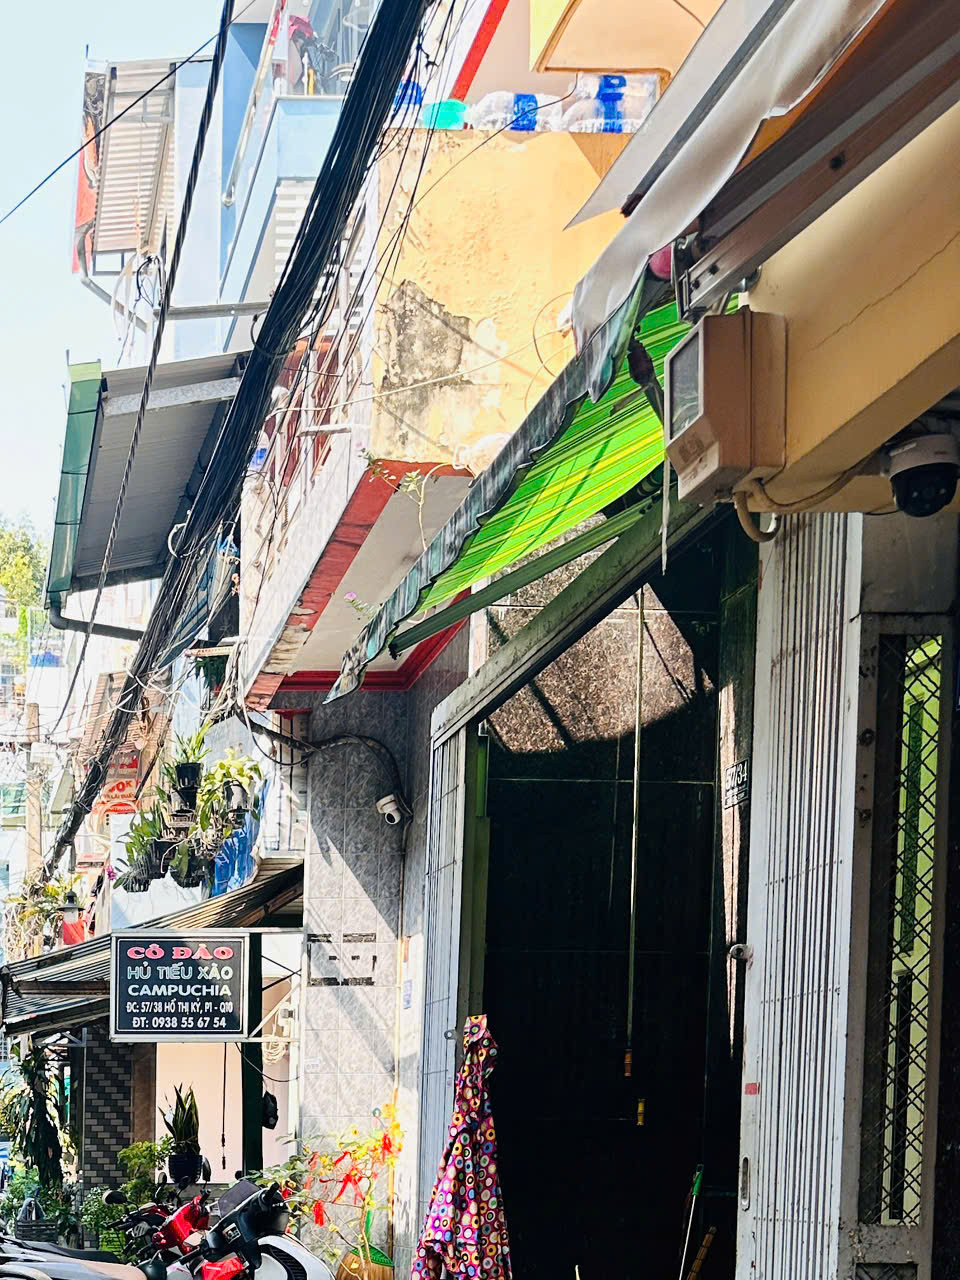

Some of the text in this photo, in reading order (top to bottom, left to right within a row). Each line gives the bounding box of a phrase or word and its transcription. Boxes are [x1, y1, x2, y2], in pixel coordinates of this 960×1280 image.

[127, 944, 234, 960] CÔ ĐÀO
[127, 961, 234, 980] HỦ TIẾU XÀO
[128, 985, 232, 997] CAMPUCHIA
[126, 1002, 139, 1013] ĐC:
[141, 1002, 163, 1013] 57/38
[178, 1002, 190, 1015] THỊ
[132, 1017, 227, 1028] ĐT: 0938 55 67 54
